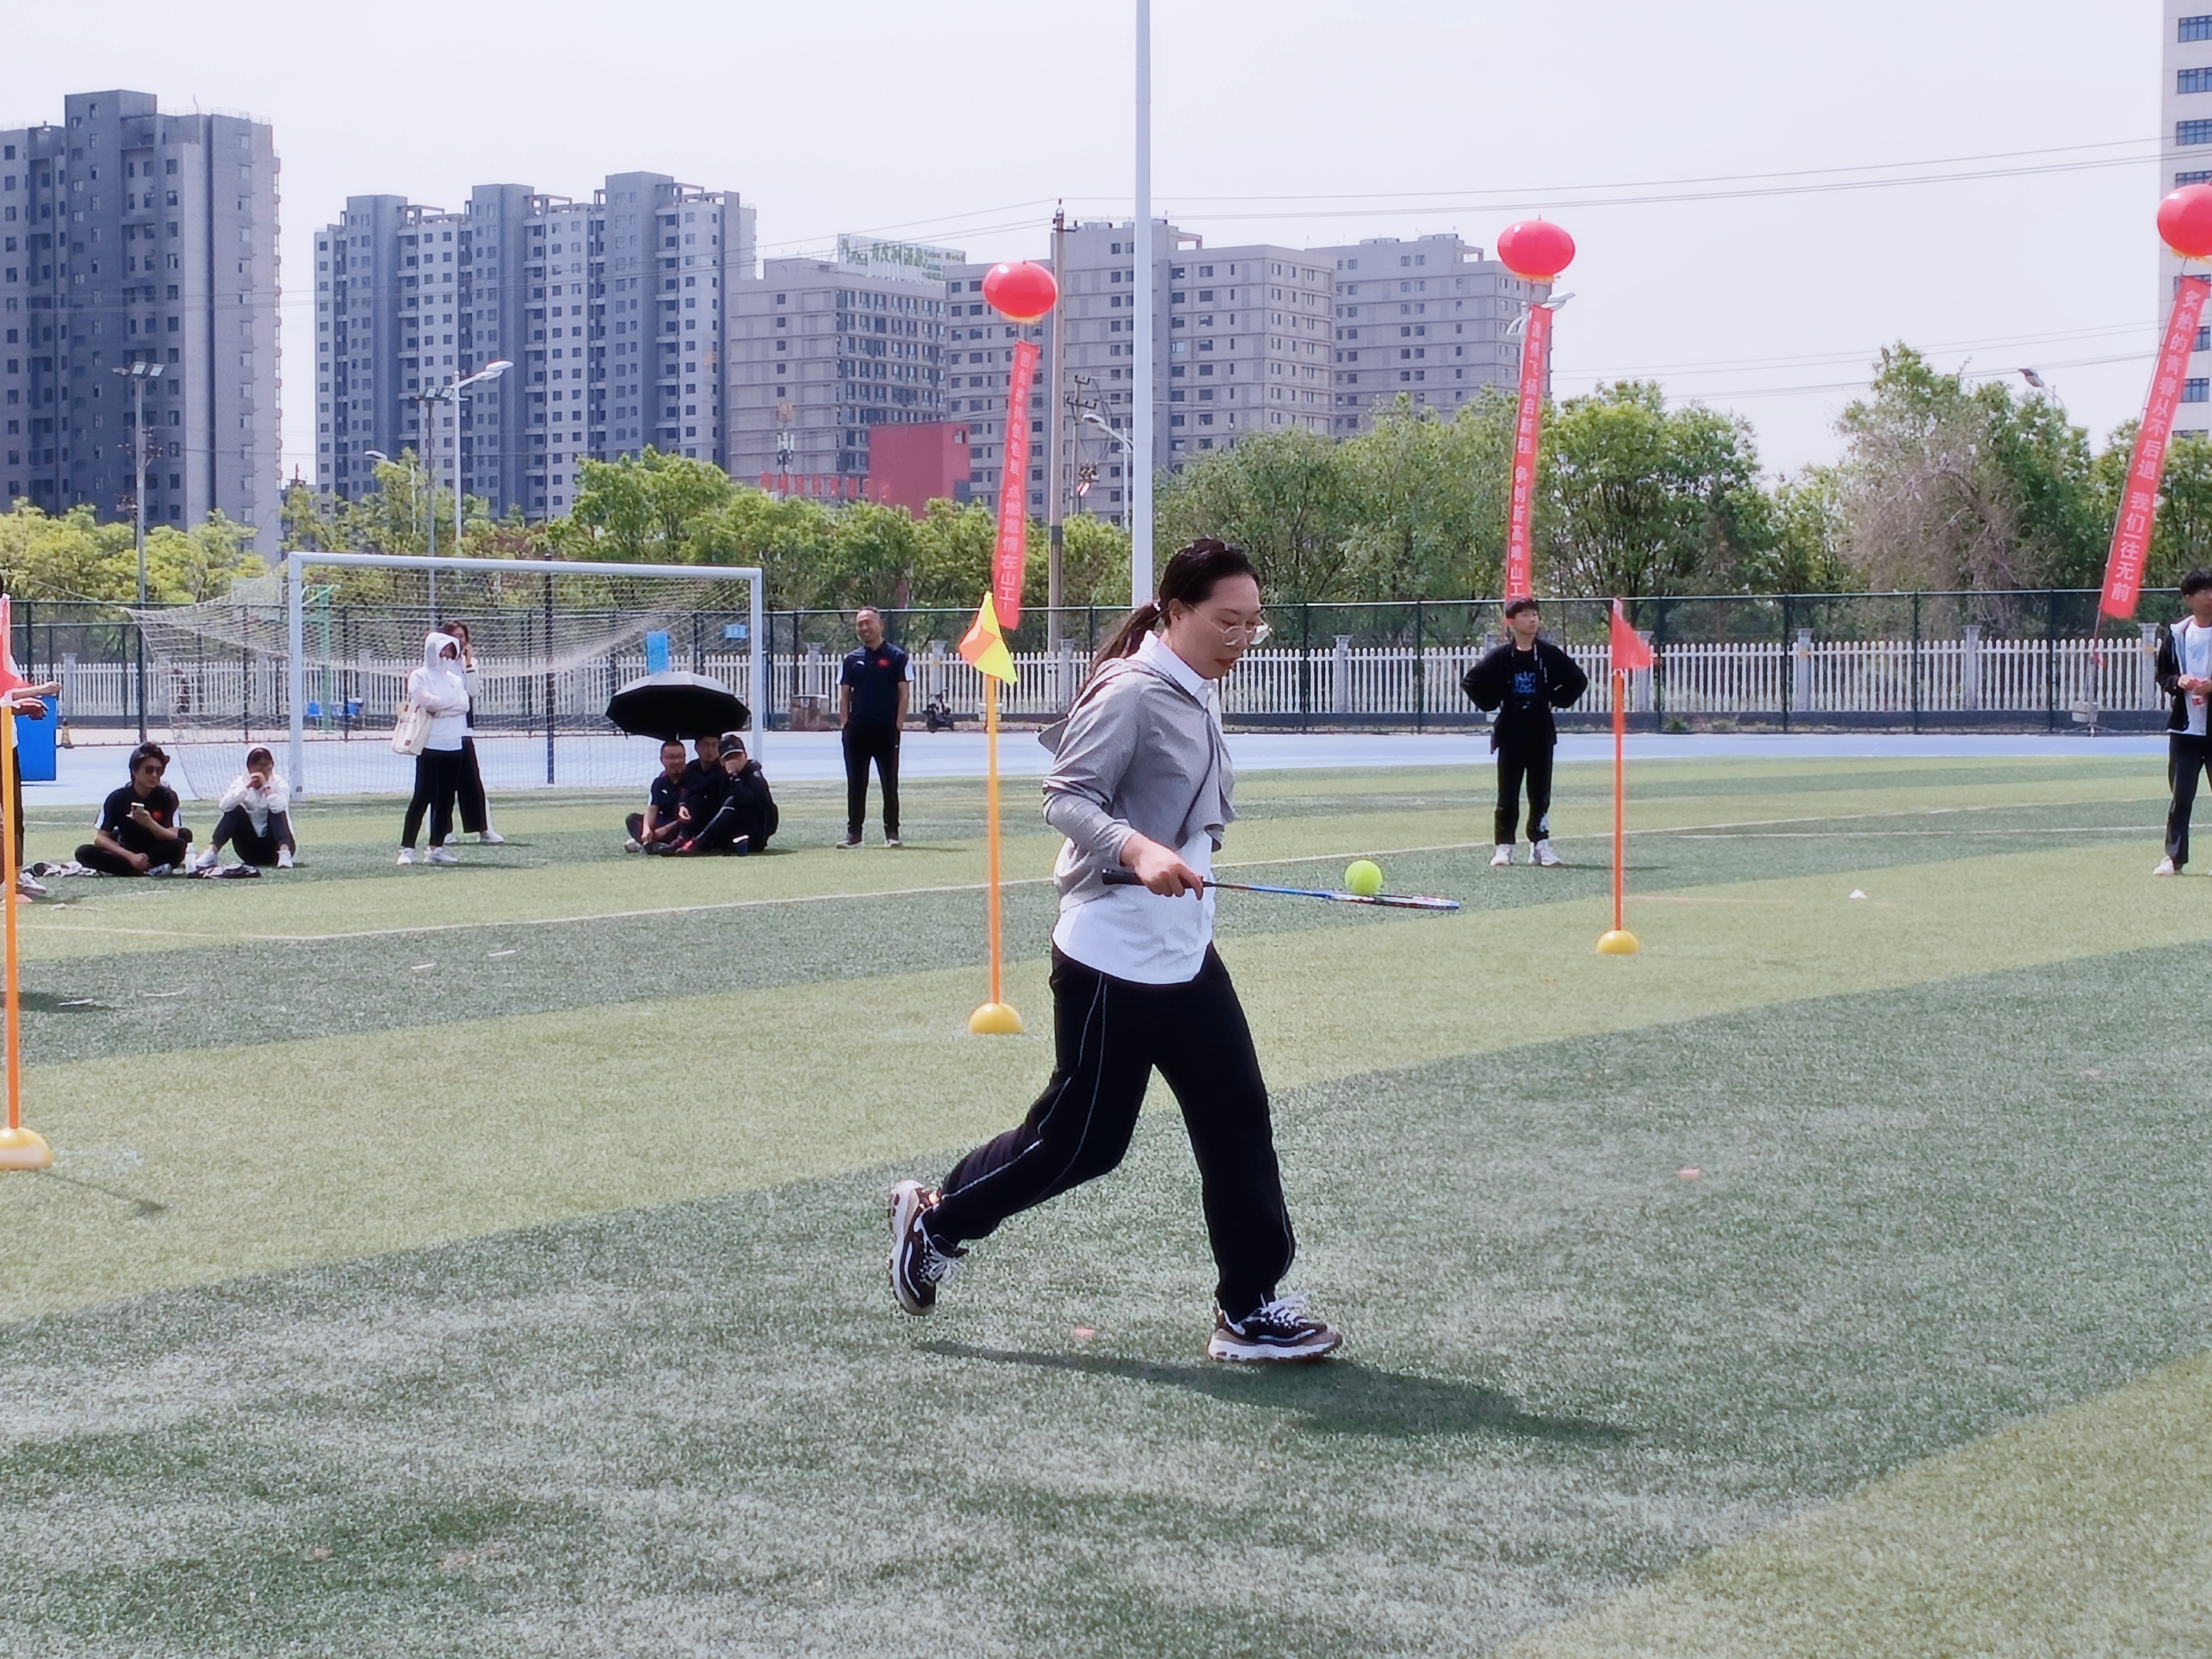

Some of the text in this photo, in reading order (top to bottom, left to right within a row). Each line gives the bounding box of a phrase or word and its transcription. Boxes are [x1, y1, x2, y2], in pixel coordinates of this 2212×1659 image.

[2111, 491, 2149, 602] 我们一往无前
